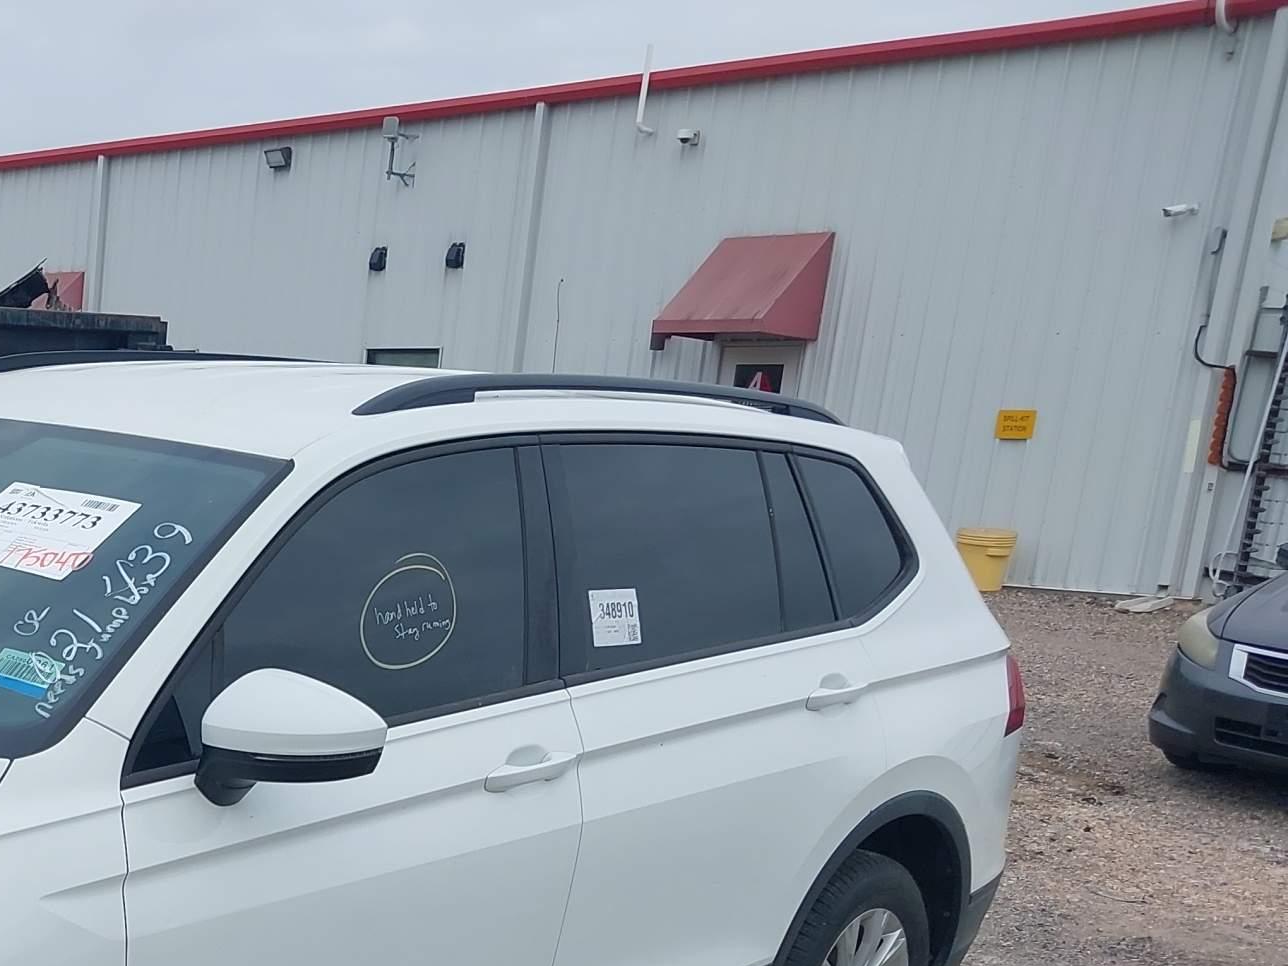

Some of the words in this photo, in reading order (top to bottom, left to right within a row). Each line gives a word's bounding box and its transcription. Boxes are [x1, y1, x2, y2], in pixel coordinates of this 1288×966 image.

[404, 596, 425, 617] held
[427, 593, 438, 612] to
[598, 601, 634, 620] 348910
